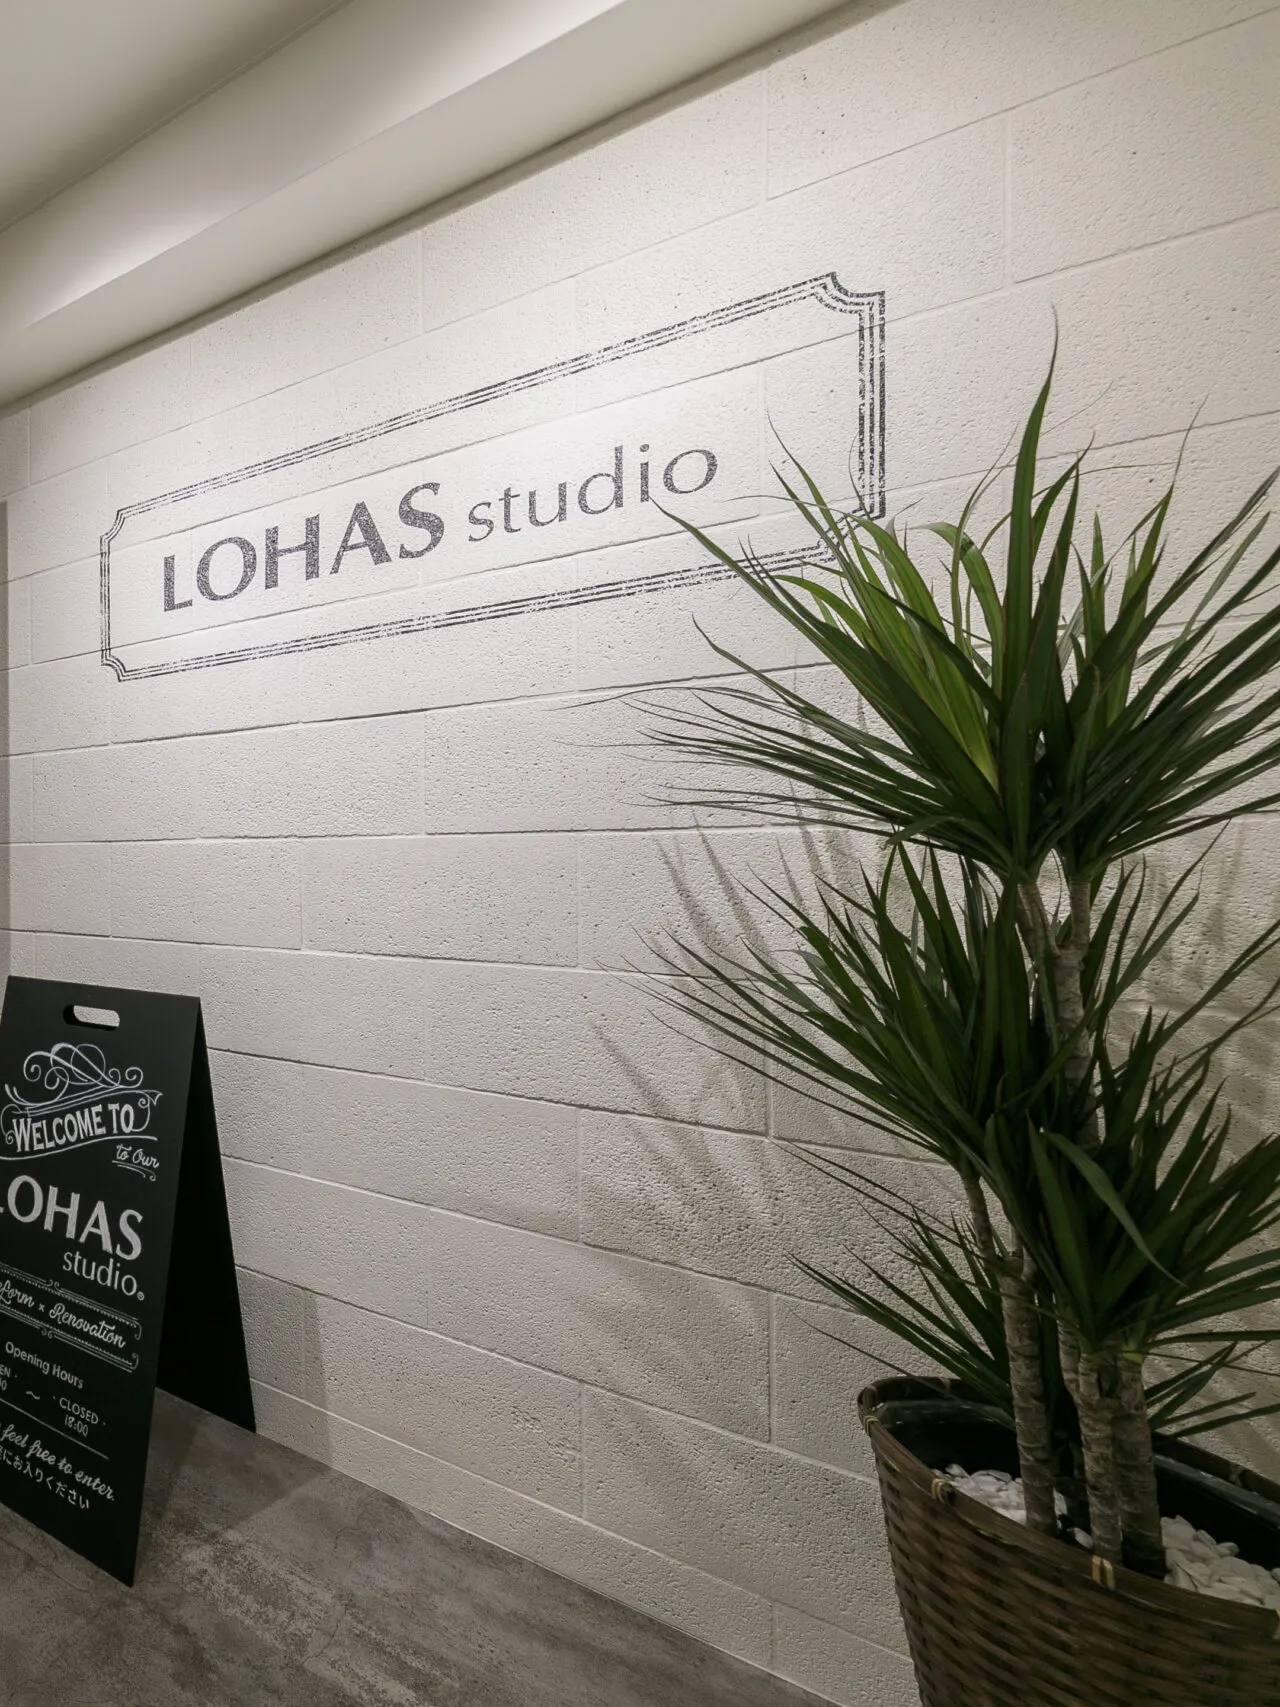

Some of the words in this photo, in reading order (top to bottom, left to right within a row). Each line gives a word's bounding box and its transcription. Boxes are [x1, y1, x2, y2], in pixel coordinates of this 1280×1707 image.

[162, 480, 446, 613] LOHAS
[467, 442, 719, 542] studio
[12, 1103, 107, 1152] WELCOME
[108, 1103, 135, 1134] TO
[116, 1143, 130, 1161] to
[132, 1148, 160, 1168] Our
[48, 1302, 126, 1348] Renovation
[5, 1341, 50, 1375] Opening
[51, 1363, 84, 1390] Hours
[59, 1397, 99, 1425] CLOSED
[64, 1414, 89, 1438] 18:00
[0, 1423, 30, 1448] feel
[25, 1439, 57, 1465] free
[57, 1457, 73, 1474] to
